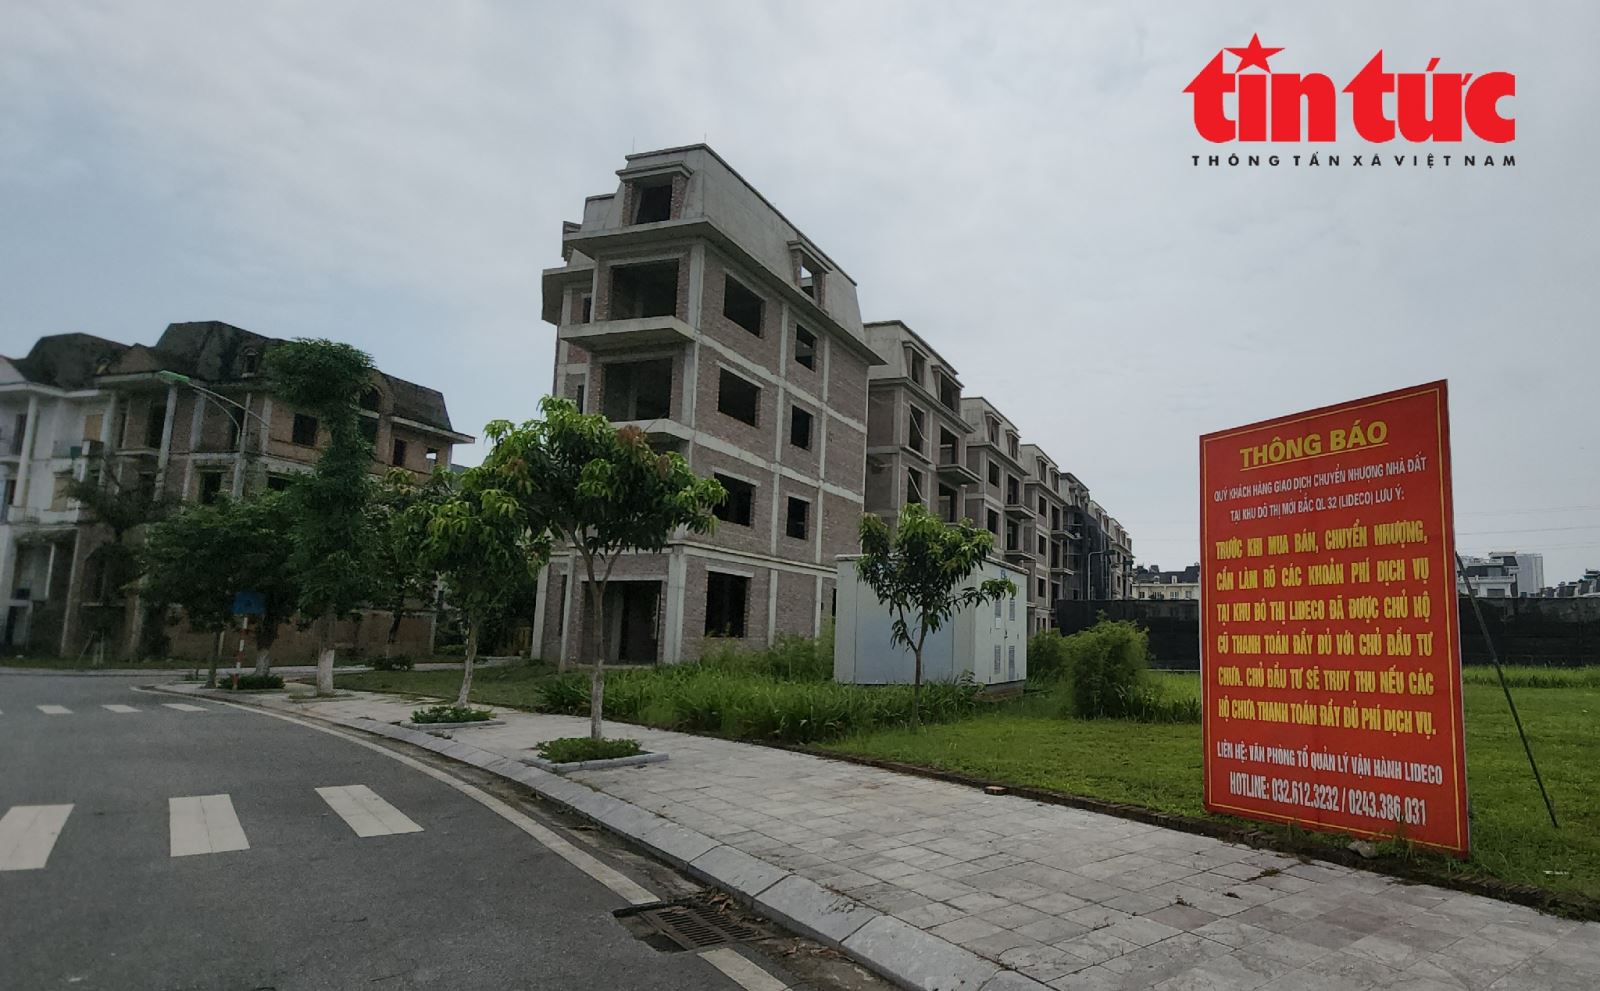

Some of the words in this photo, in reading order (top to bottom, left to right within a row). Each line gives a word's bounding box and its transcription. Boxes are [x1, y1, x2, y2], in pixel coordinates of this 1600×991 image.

[1240, 436, 1322, 467] THÔNG
[1330, 420, 1388, 451] BÁO
[1214, 486, 1228, 502] QUÝ
[1229, 483, 1251, 500] KHÁCH
[1253, 481, 1273, 496] HÀNG
[1274, 478, 1292, 493] GIAO
[1293, 475, 1312, 493] DỊCH
[1313, 463, 1346, 487] CHUYỂN
[1347, 464, 1384, 483] NHƯỢNG
[1386, 457, 1406, 475] NHÀ
[1407, 451, 1427, 472] ĐẤT
[1230, 510, 1241, 525] TẠI
[1242, 507, 1256, 520] KHU
[1269, 503, 1281, 519] THỊ
[1297, 492, 1314, 512] BẮC
[1315, 498, 1326, 511] QL
[1327, 496, 1337, 511] 32
[1338, 490, 1374, 510] (LIDECO)
[1375, 487, 1393, 503] LƯU
[1395, 483, 1405, 500] Ý:
[1216, 536, 1243, 560] TRƯỚC
[1247, 537, 1263, 557] KHI
[1267, 534, 1289, 555] MUA
[1294, 528, 1319, 554] BÁN,
[1325, 518, 1368, 550] CHUYỂN
[1239, 566, 1258, 589] LÀM
[1263, 564, 1276, 588] RÕ
[1281, 562, 1302, 587] CÁC
[1308, 557, 1344, 586] KHOẢN
[1351, 557, 1370, 584] PHÍ
[1377, 559, 1406, 586] DỊCH
[1412, 557, 1430, 585] VỤ
[1216, 603, 1230, 626] TẠI
[1233, 602, 1251, 622] KHU
[1254, 598, 1266, 622] ĐÔ
[1270, 601, 1286, 625] THỊ
[1289, 599, 1325, 621] LIDECO
[1329, 594, 1344, 620] ĐÃ
[1349, 595, 1379, 624] ĐƯỢC
[1383, 588, 1409, 619] CHỦ
[1413, 590, 1431, 623] HỘ
[1231, 635, 1261, 655] THANH
[1264, 630, 1289, 655] TOÁN
[1317, 627, 1332, 656] ĐỦ
[1336, 629, 1355, 656] VỚI
[1359, 626, 1382, 656] CHỦ
[1416, 631, 1434, 657] TƯ
[1246, 661, 1265, 688] CHỦ
[1290, 666, 1304, 690] TƯ
[1306, 665, 1320, 690] SẼ
[1323, 670, 1351, 692] TRUY
[1354, 670, 1376, 693] THU
[1380, 664, 1405, 695] NẾU
[1408, 667, 1434, 696] CÁC
[1218, 695, 1230, 723] HỘ
[1231, 698, 1256, 720] CHƯA
[1257, 701, 1289, 723] THANH
[1290, 700, 1318, 726] TOÁN
[1343, 700, 1360, 729] ĐỦ
[1361, 704, 1381, 731] PHÍ
[1383, 709, 1413, 737] DỊCH
[1415, 711, 1437, 740] VỤ.
[1216, 739, 1234, 759] LIÊN
[1234, 740, 1248, 764] HỆ:
[1248, 742, 1266, 763] VĂN
[1266, 743, 1296, 767] PHÒNG
[1296, 744, 1309, 769] TỔ
[1310, 745, 1336, 772] QUẢN
[1337, 752, 1349, 774] LÝ
[1351, 753, 1372, 779] VẬN
[1373, 755, 1402, 780] HÀNH
[1404, 761, 1443, 785] LIDECO
[1229, 771, 1270, 800] HOTLINE:
[1271, 777, 1340, 812] 032.612.3232
[1341, 787, 1346, 813] /
[1348, 788, 1426, 826] 0243.386.031
